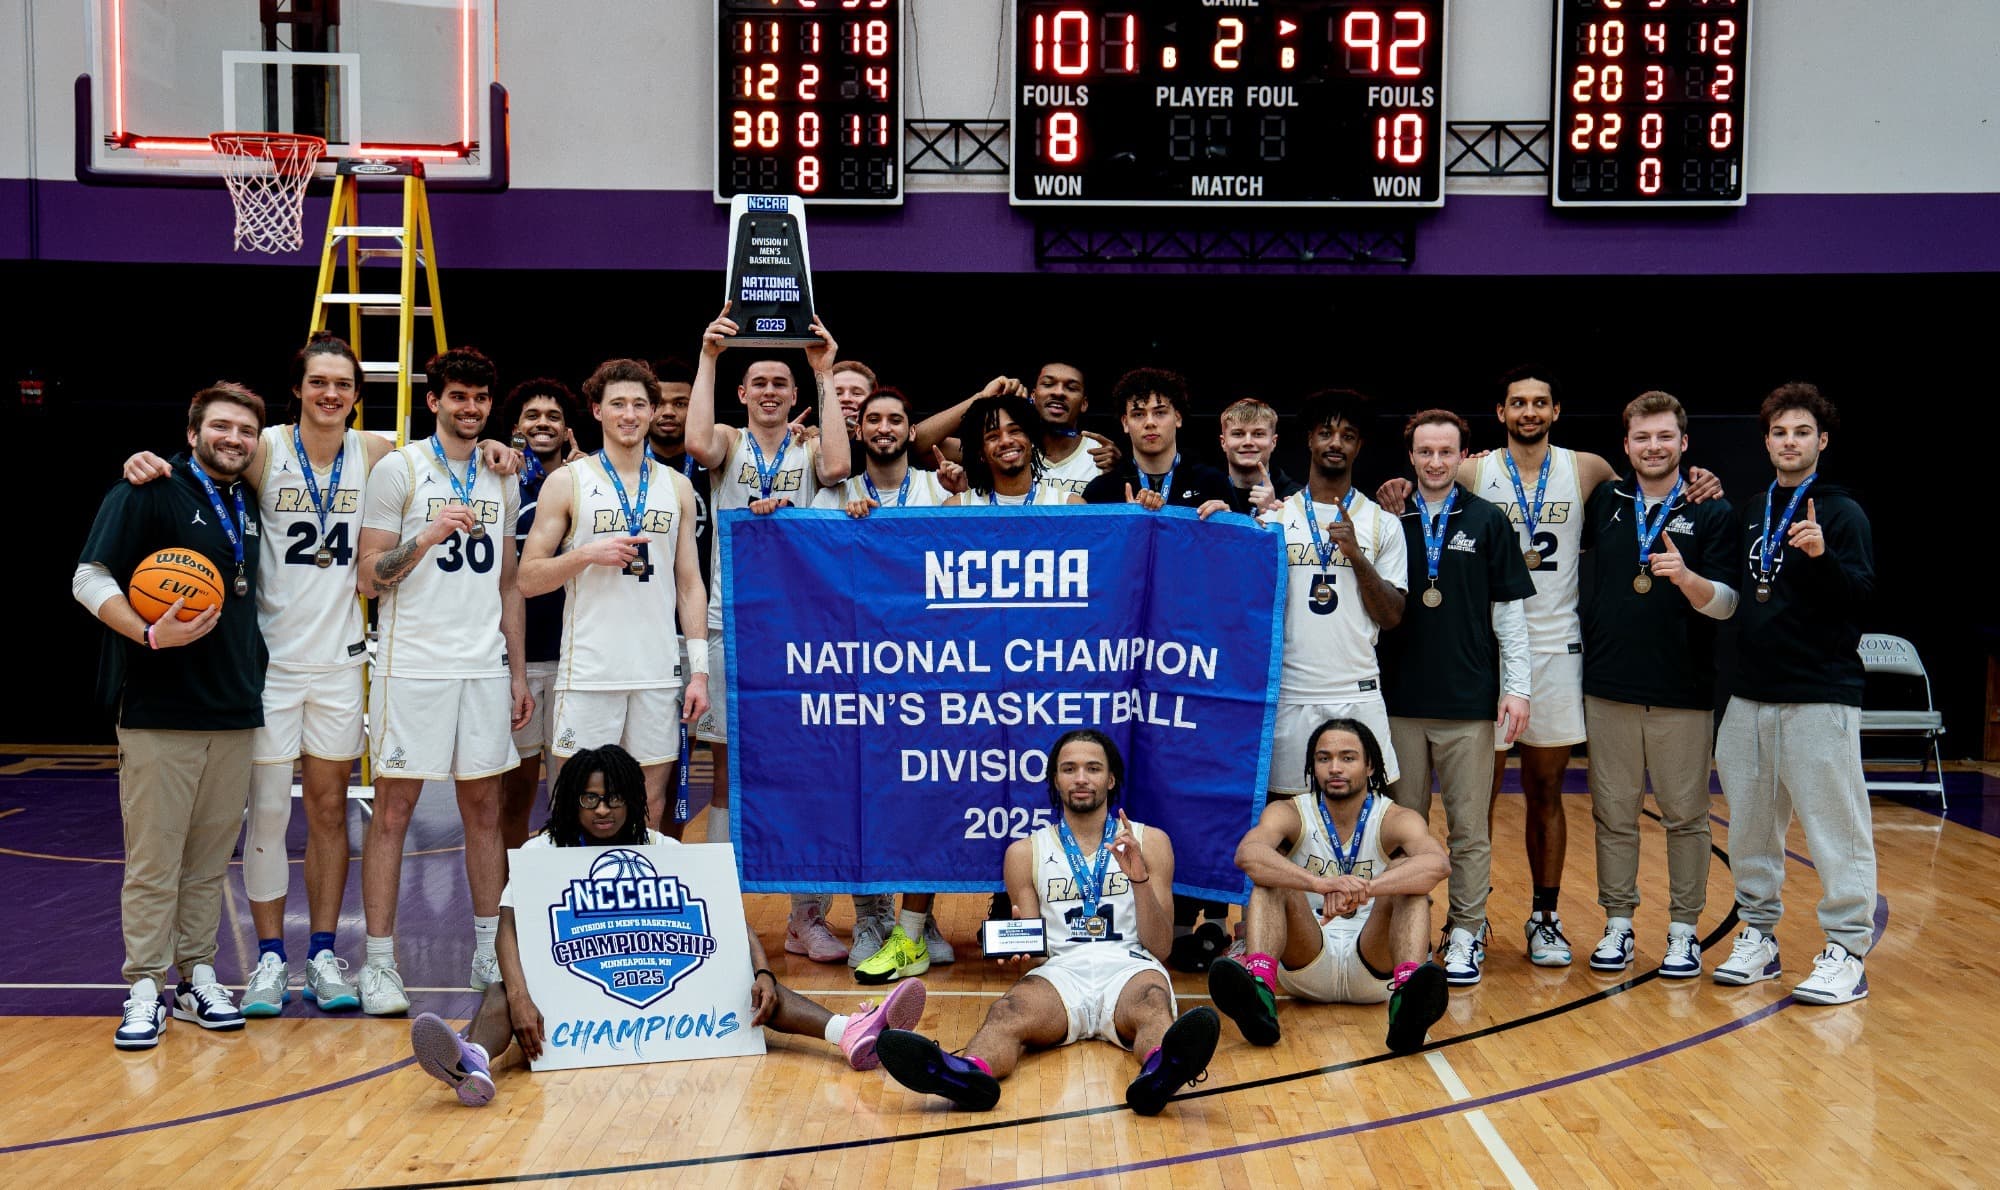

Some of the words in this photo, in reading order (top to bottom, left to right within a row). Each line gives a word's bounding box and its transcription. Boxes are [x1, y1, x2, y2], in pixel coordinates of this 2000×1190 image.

[744, 22, 779, 53] 11
[812, 22, 820, 53] 1
[853, 20, 887, 56] 18
[1035, 11, 1134, 75] 101
[1213, 18, 1244, 69] 2
[1344, 11, 1426, 75] 92
[1589, 20, 1624, 57] 10
[1644, 23, 1665, 53] 4
[1700, 20, 1735, 56] 12
[744, 63, 779, 100] 12
[799, 64, 819, 100] 2
[866, 67, 887, 98] 4
[1023, 85, 1089, 106] FOULS
[1156, 86, 1234, 107] PLAYER
[1247, 86, 1299, 107] FOUL
[1368, 86, 1435, 107] FOULS
[1573, 65, 1623, 101] 20
[1645, 65, 1663, 101] 3
[1712, 65, 1733, 101] 2
[733, 111, 779, 148] 30
[798, 112, 819, 147] 0
[853, 114, 887, 145] 11
[1048, 112, 1078, 162] 8
[1376, 113, 1422, 163] 10
[1571, 113, 1622, 150] 22
[1641, 113, 1662, 149] 0
[1711, 113, 1732, 148] 0
[798, 156, 819, 191] 8
[1034, 175, 1082, 196] WON
[1191, 176, 1263, 196] MATCH
[1373, 176, 1421, 197] WON
[1639, 157, 1661, 193] 0
[749, 197, 788, 210] NCCAA
[751, 238, 782, 247] DIVISION
[783, 238, 789, 247] II
[759, 247, 781, 255] MEN'S
[749, 256, 792, 265] BASKETBALL
[741, 289, 800, 302] CHAMPION
[742, 276, 799, 289] NATIONAL
[756, 319, 786, 332] 2025
[285, 521, 353, 566] 24
[436, 530, 495, 574] 30
[1287, 543, 1369, 567] RAM
[1514, 530, 1559, 572] 2
[155, 552, 216, 580] Wilson
[925, 549, 1089, 600] NCCAA
[159, 578, 199, 598] EVO
[1308, 574, 1339, 615] 5
[786, 639, 991, 675] NATIONAL
[1004, 637, 1218, 679] CHAMPION
[940, 688, 1198, 730] BASKETBALL
[901, 749, 1049, 783] DIVISIO
[963, 807, 1052, 839] 2025
[1304, 854, 1373, 880] RAS
[573, 879, 681, 911] NCCAA
[1047, 871, 1129, 903] RAS
[571, 921, 606, 935] DIVISION
[607, 920, 614, 928] II
[615, 919, 641, 928] MEN'S
[641, 919, 692, 930] BASKETBALL
[553, 932, 717, 966] CHAMPIONSHIP
[600, 958, 657, 970] MINNEAPOLIS,
[658, 958, 672, 967] MN
[613, 970, 665, 988] 2025
[551, 1003, 740, 1059] CHAMPIONS
